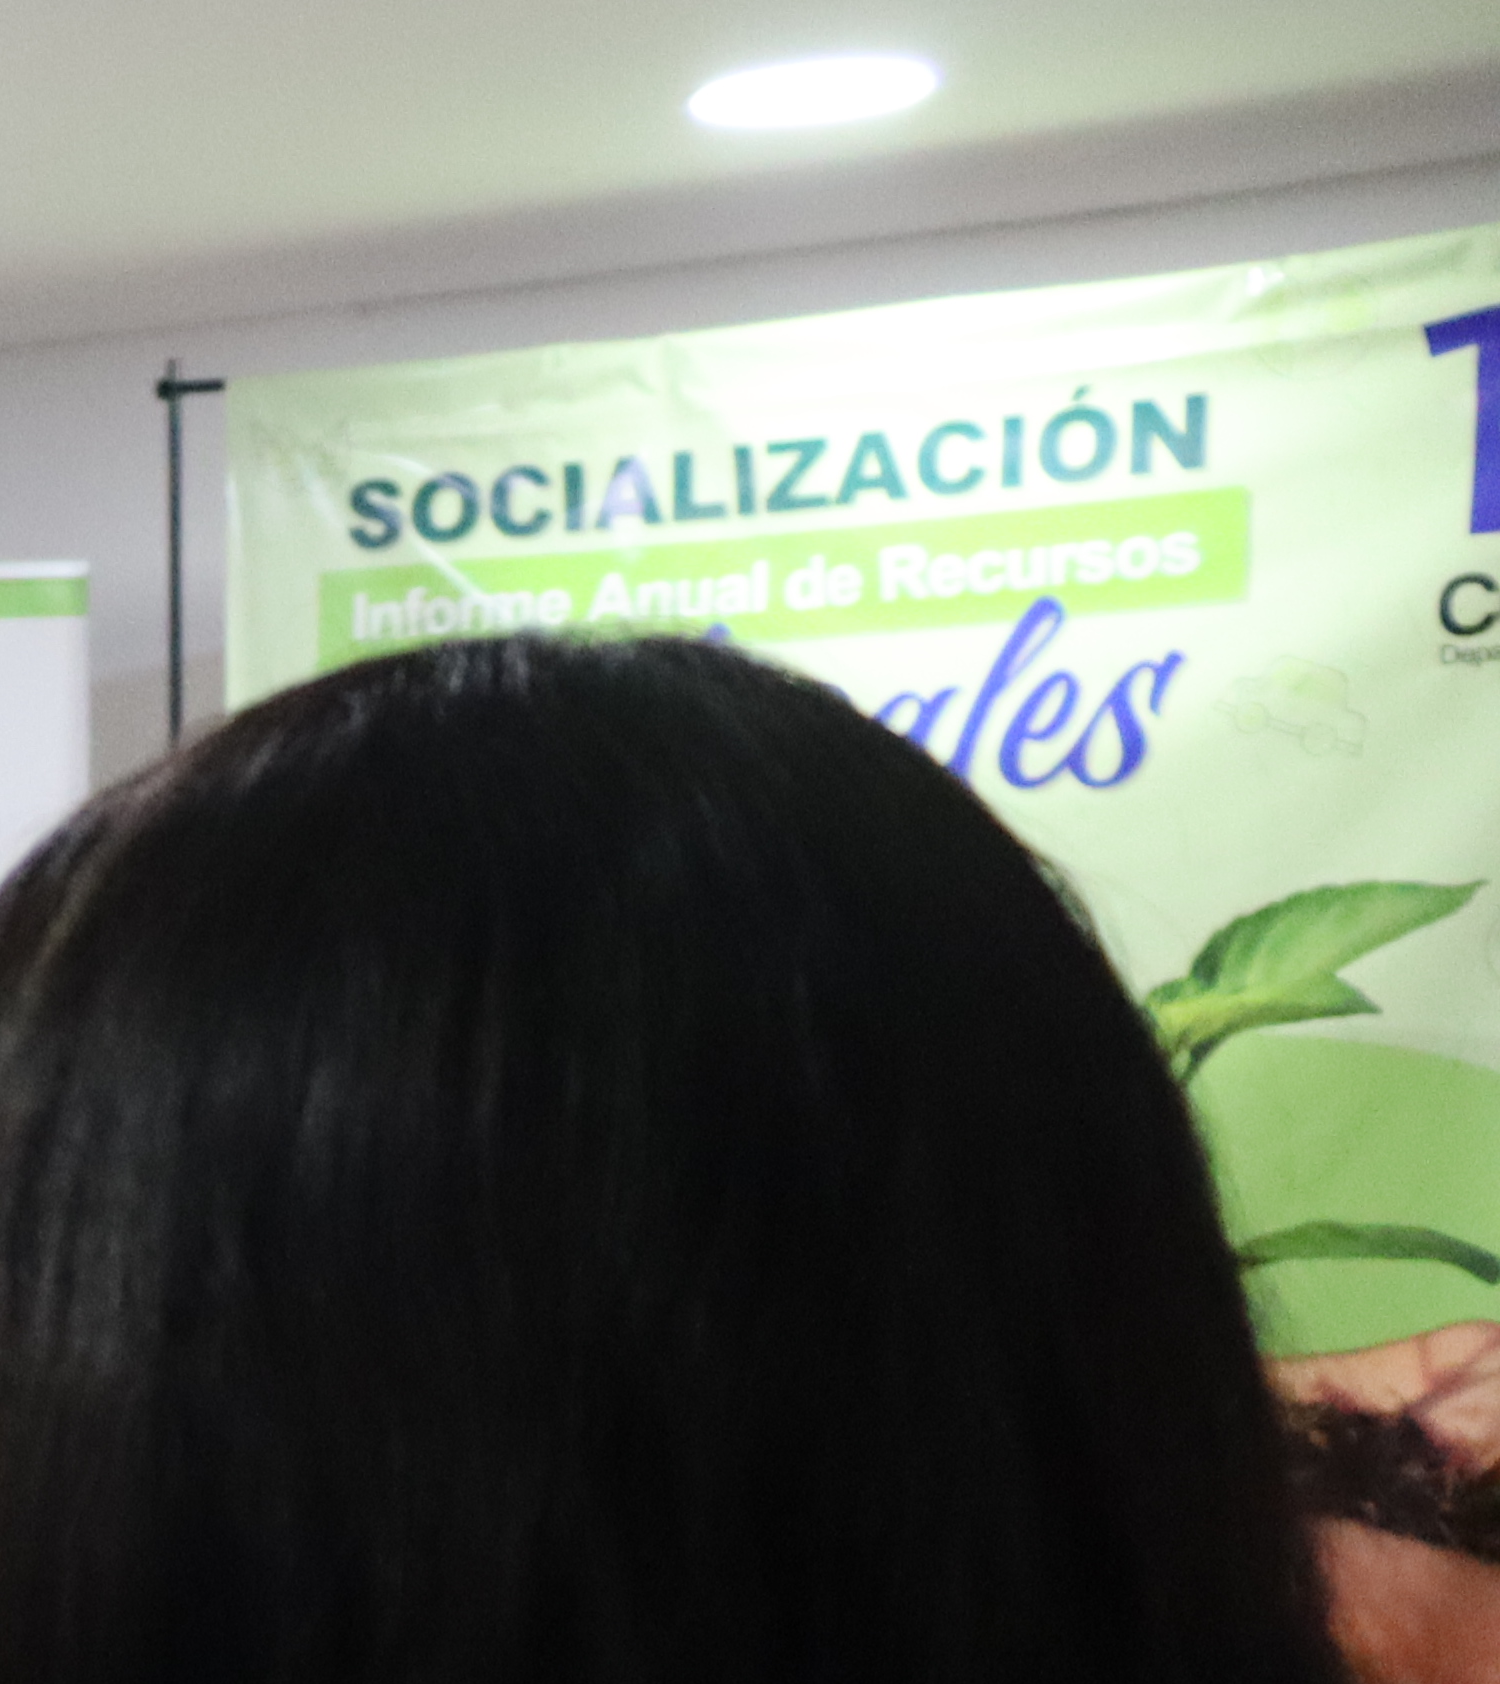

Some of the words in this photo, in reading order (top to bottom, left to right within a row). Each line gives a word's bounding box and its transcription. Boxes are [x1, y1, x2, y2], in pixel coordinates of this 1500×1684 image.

[350, 384, 1209, 549] SOCIALIZACIÓN
[352, 585, 571, 640] Informe
[588, 560, 770, 622] Anual
[784, 553, 863, 611] de
[877, 530, 1201, 601] Recursos
